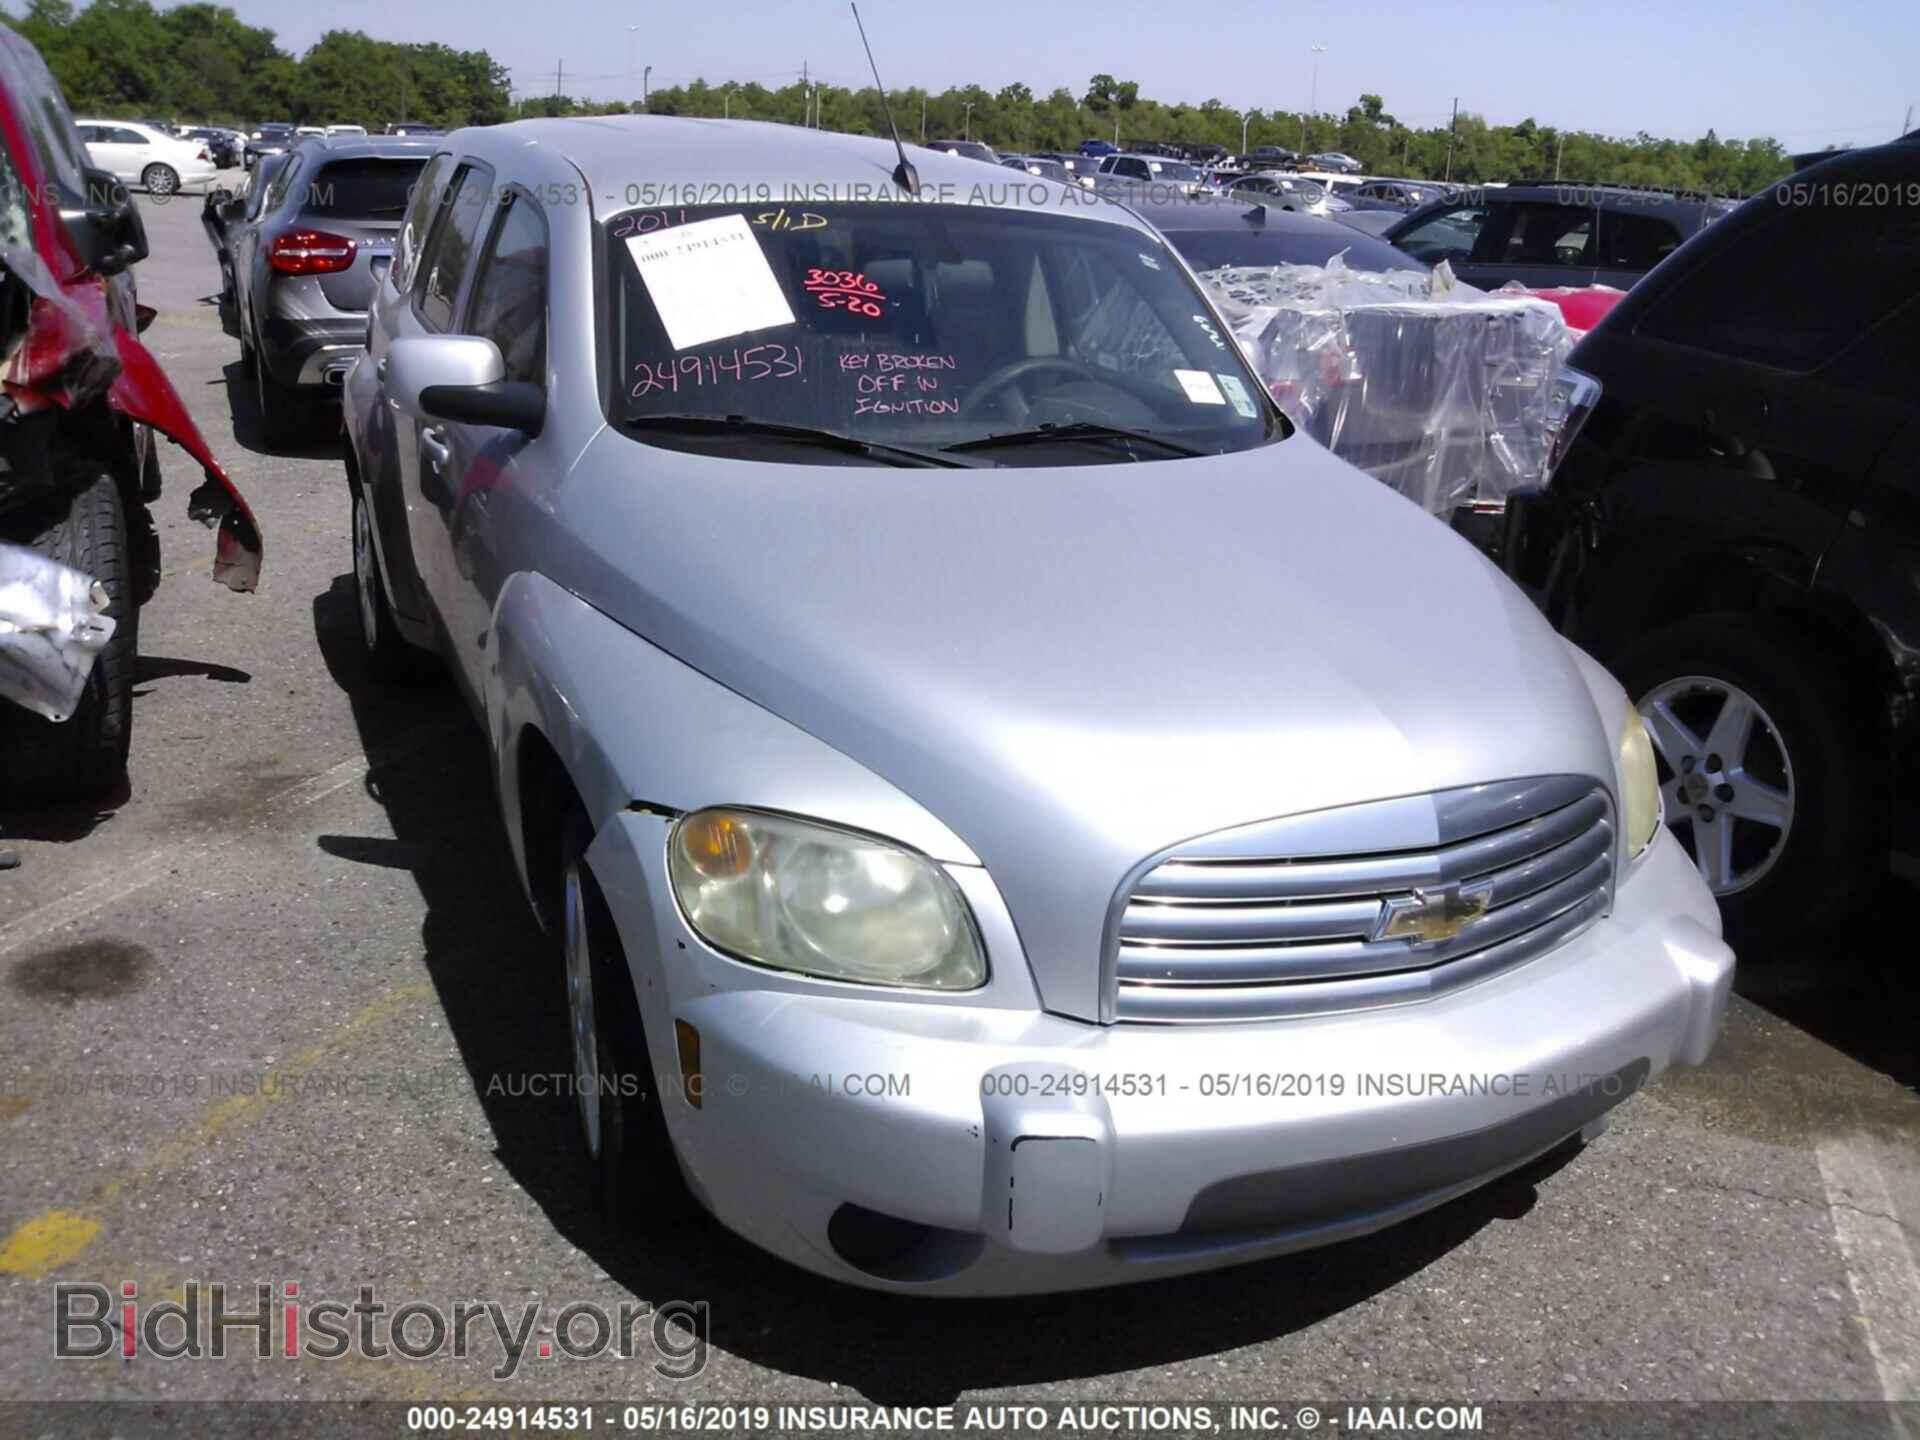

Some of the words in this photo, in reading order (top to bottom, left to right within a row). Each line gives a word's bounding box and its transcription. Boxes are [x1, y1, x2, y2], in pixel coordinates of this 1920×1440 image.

[613, 209, 688, 238] 2011
[803, 268, 879, 292] 3036
[818, 292, 881, 317] 5-20
[839, 353, 870, 372] KEY
[876, 353, 956, 373] BROKEN
[857, 374, 905, 394] OFF
[916, 375, 938, 392] IN
[854, 397, 960, 415] IGNITION
